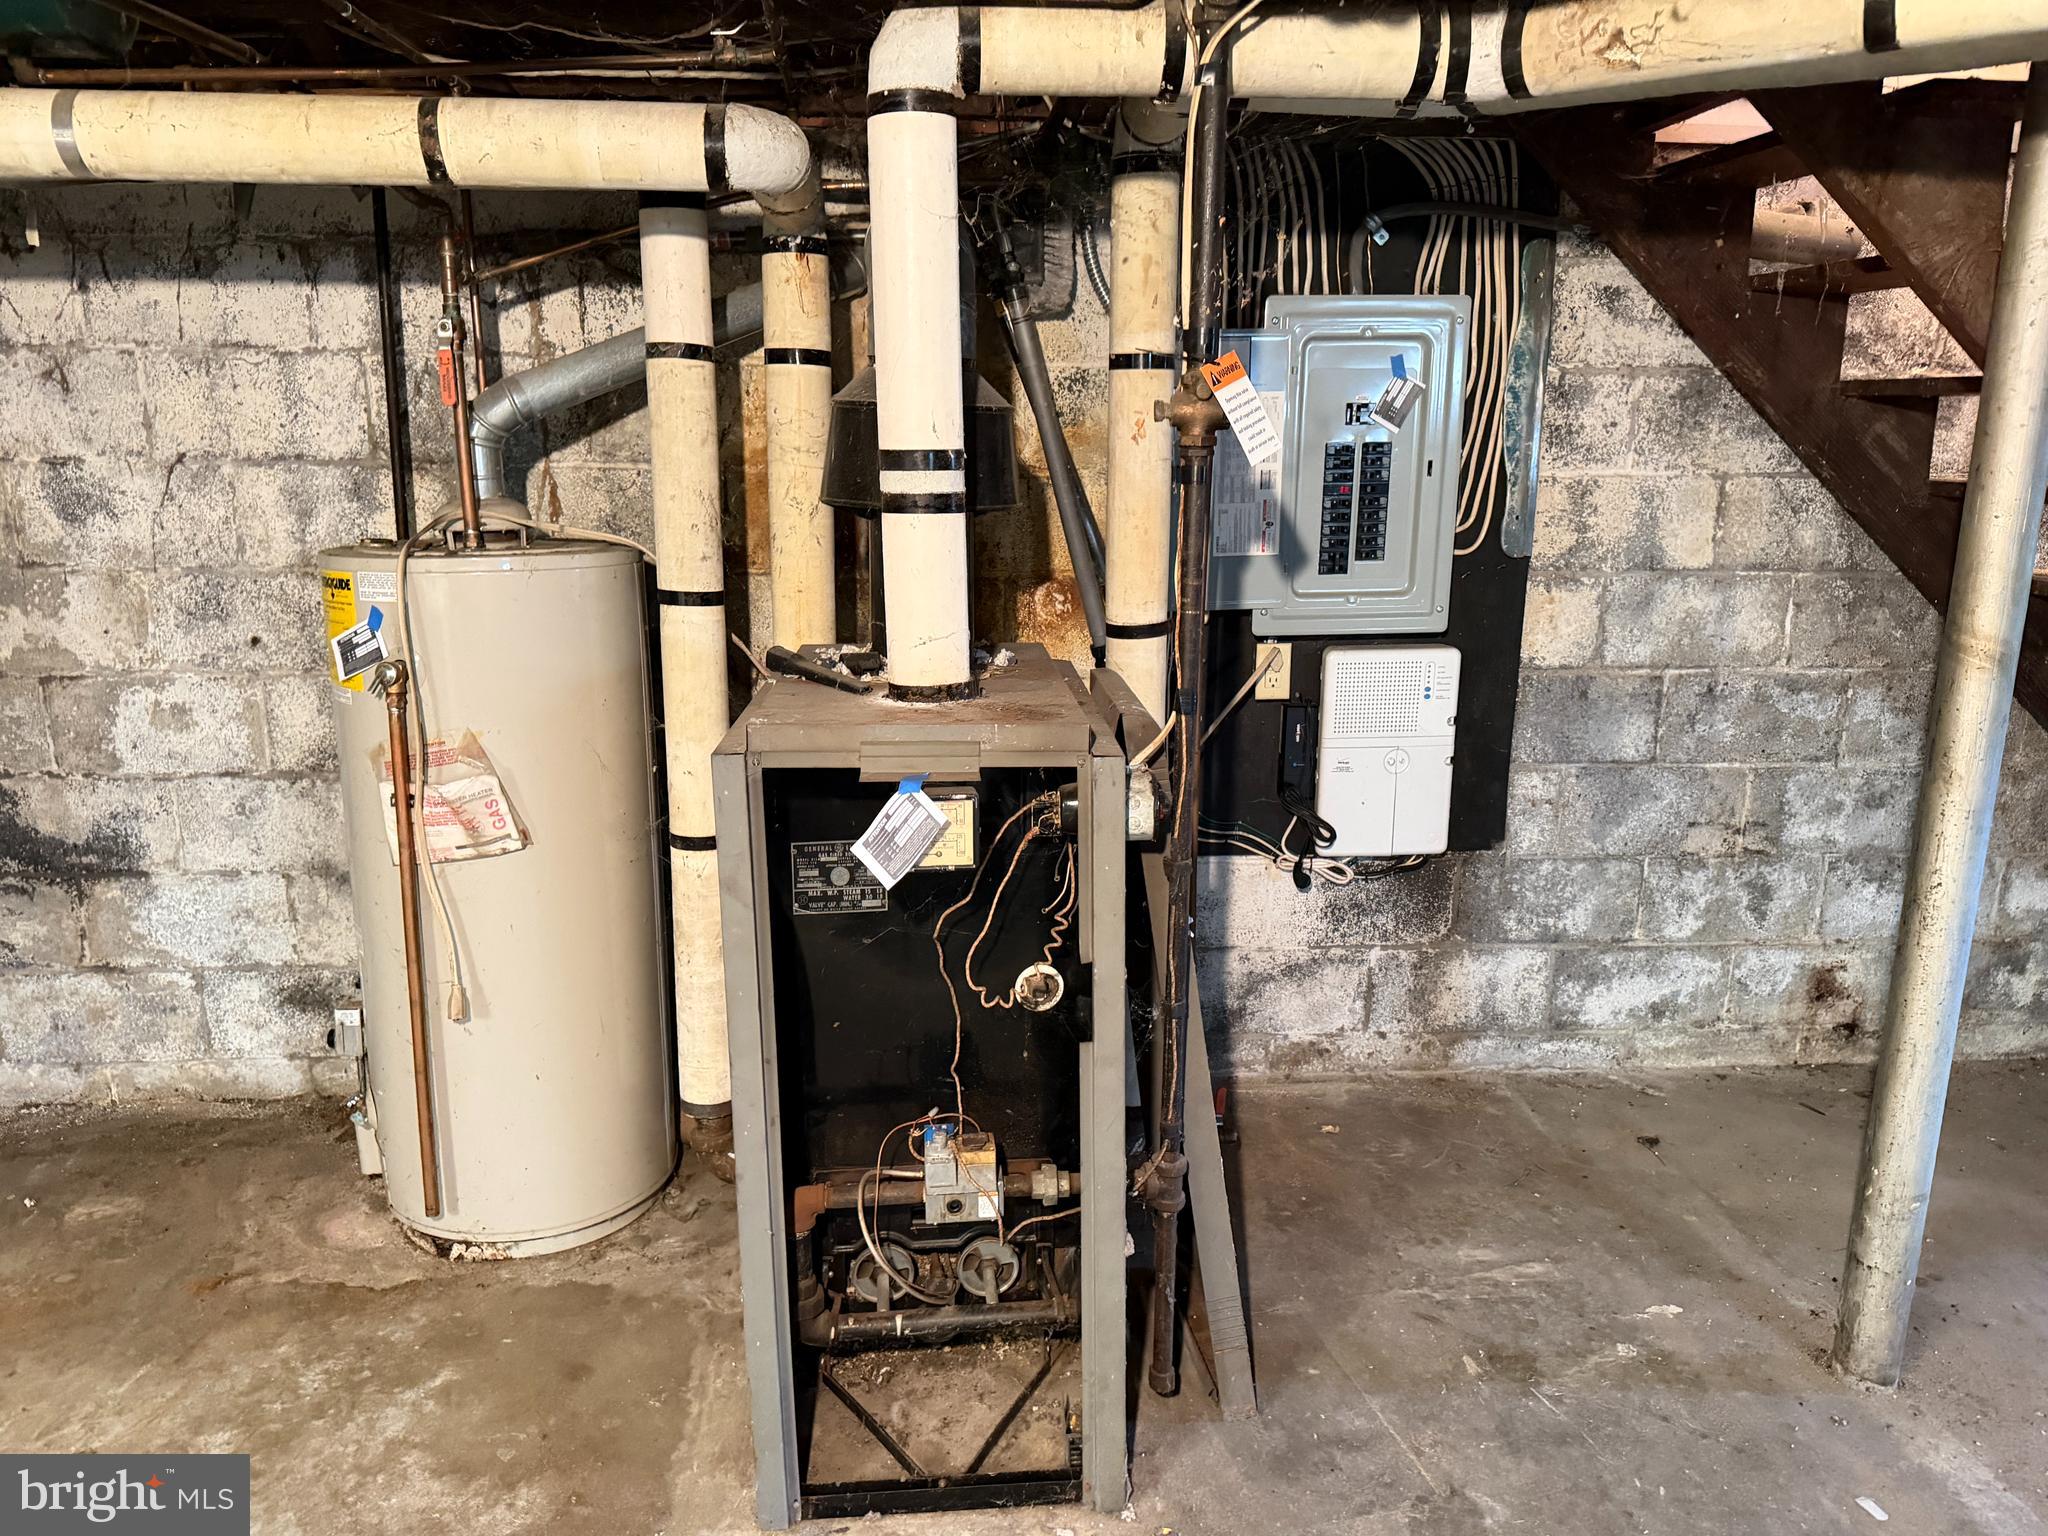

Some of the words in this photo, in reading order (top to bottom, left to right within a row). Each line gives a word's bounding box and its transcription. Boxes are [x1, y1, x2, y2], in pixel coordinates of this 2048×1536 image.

[1216, 360, 1241, 378] WARNING
[1241, 395, 1257, 407] compliance
[468, 788, 493, 799] HEATER
[485, 798, 507, 830] GAS
